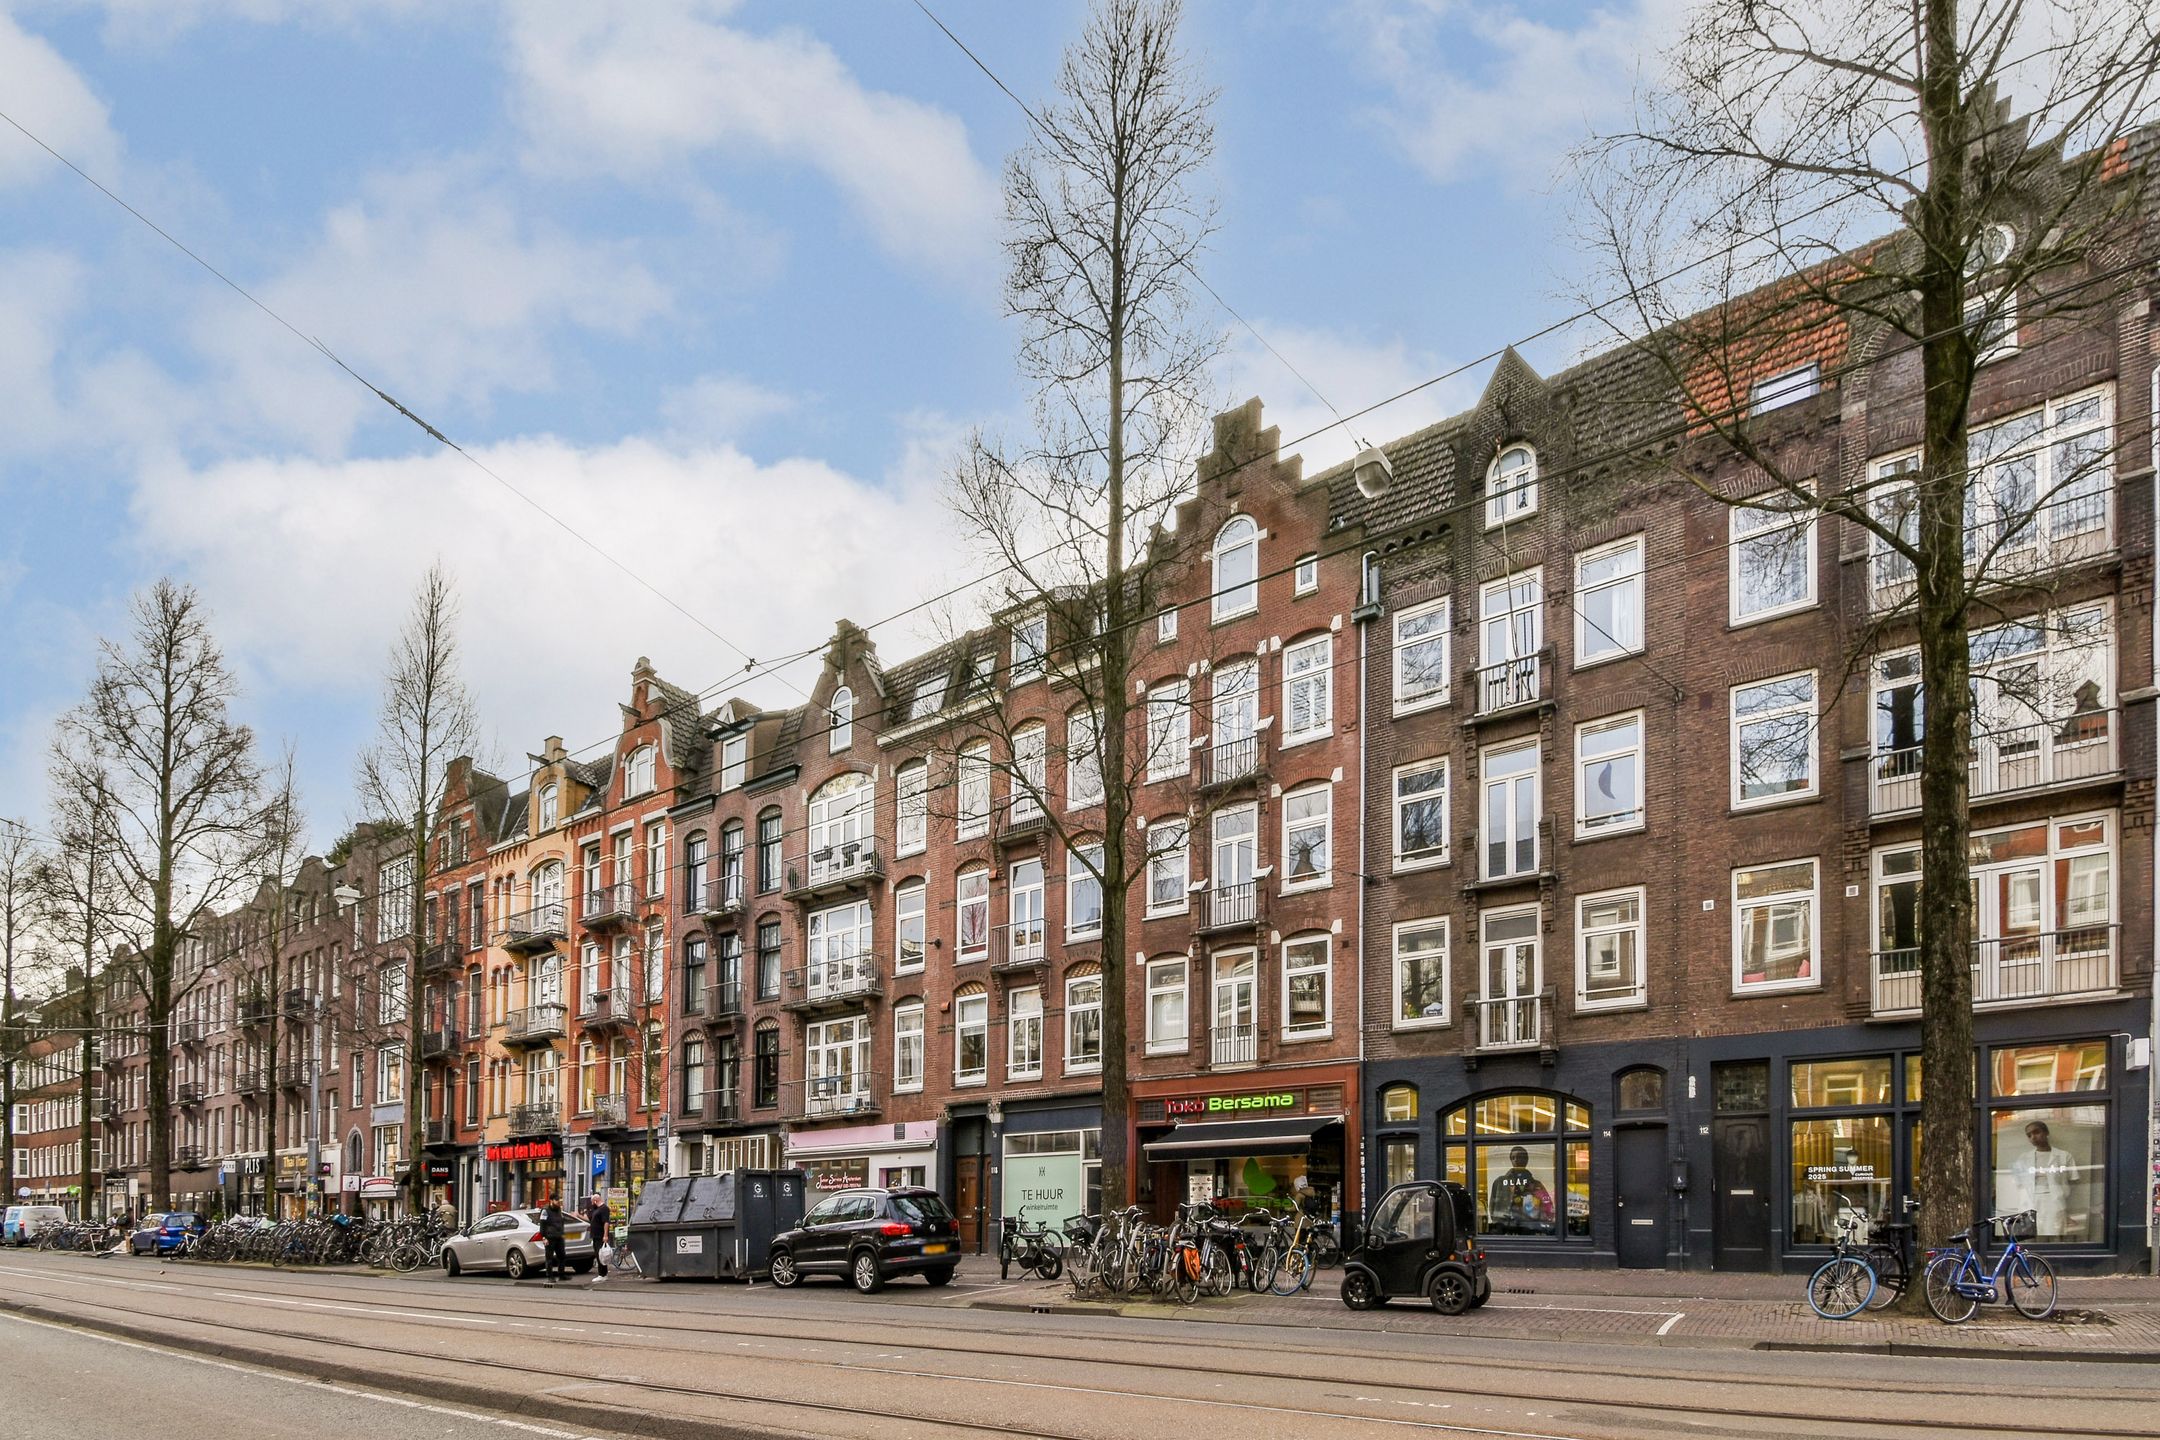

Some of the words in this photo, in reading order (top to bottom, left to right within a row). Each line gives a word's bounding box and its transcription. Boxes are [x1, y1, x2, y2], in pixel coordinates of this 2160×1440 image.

[1165, 1099, 1205, 1113] Toko
[1209, 1094, 1293, 1111] Bersama
[1699, 1126, 1709, 1134] 112
[501, 1146, 514, 1160] van
[514, 1143, 528, 1159] den
[529, 1141, 553, 1157] Broek
[245, 1158, 260, 1174] PLTS
[596, 1159, 603, 1168] P
[1021, 1189, 1033, 1200] TE
[1035, 1188, 1064, 1200] HUUR
[679, 1238, 687, 1249] G
